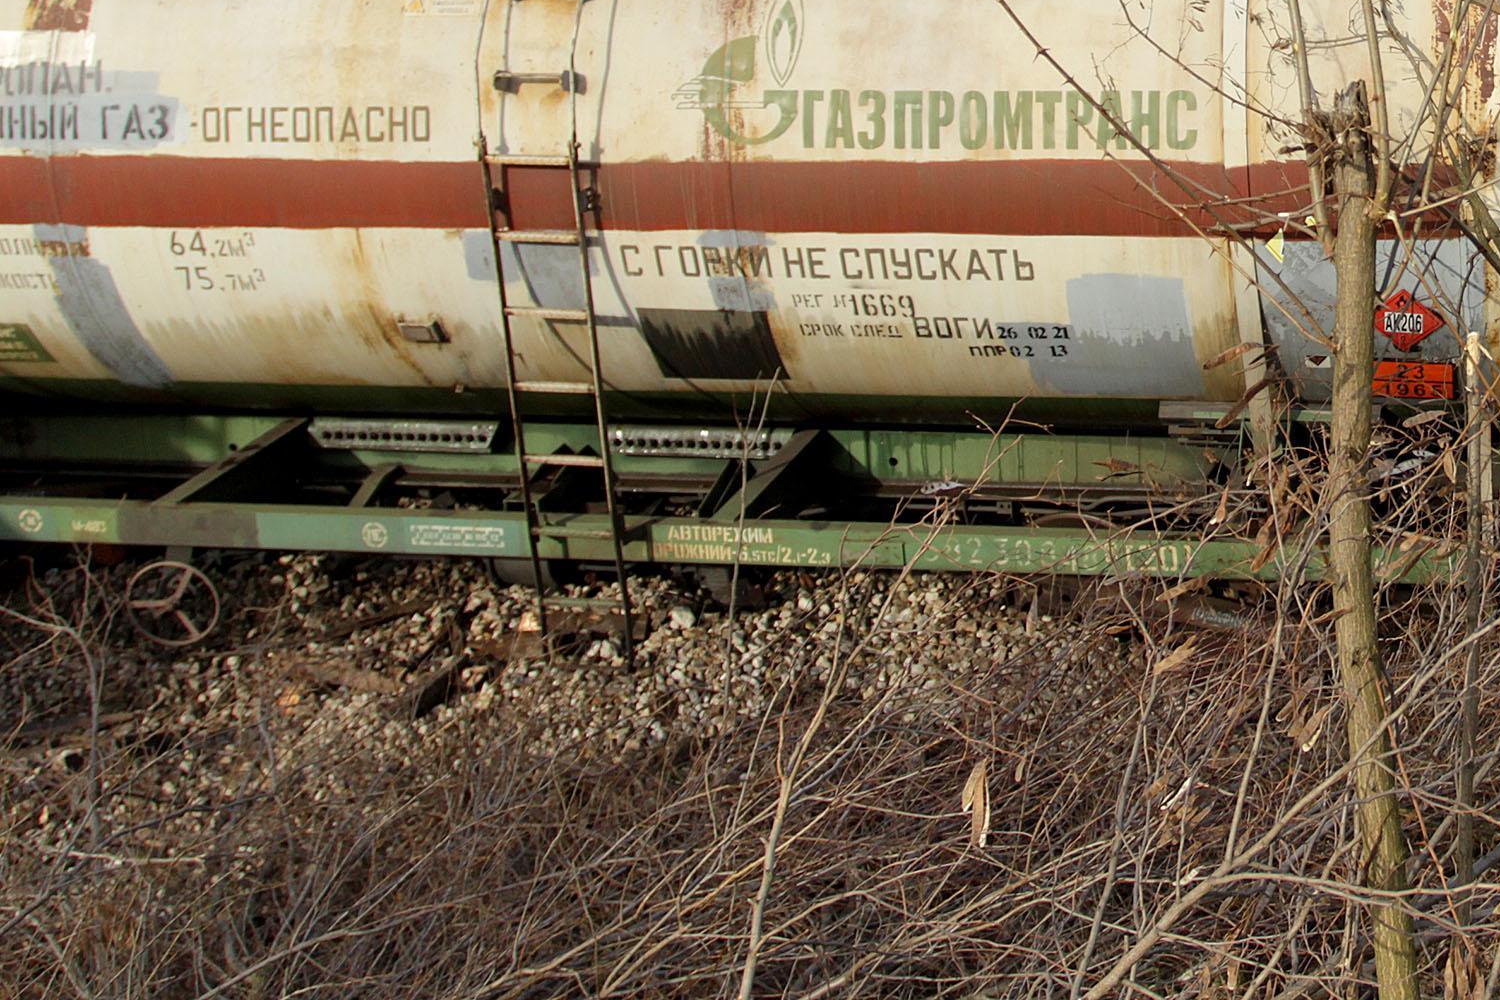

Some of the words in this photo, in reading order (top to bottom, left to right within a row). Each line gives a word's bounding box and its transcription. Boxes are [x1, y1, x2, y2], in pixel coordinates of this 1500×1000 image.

[101, 104, 170, 140] ГАЗ
[801, 88, 1199, 150] ГАЗПРОМТРАНС
[620, 245, 643, 277] С
[783, 247, 831, 279] НЕ
[839, 247, 1035, 281] СПУСКАТЬ
[799, 323, 845, 338] СРОК
[997, 326, 1018, 340] 26
[1027, 327, 1048, 340] 02
[1052, 326, 1071, 340] 21
[1010, 344, 1035, 358] 02
[1049, 344, 1069, 358] 13
[1397, 364, 1425, 380] 23
[1383, 383, 1444, 398] 1965
[667, 524, 774, 544] АВТОРЕЖИМ
